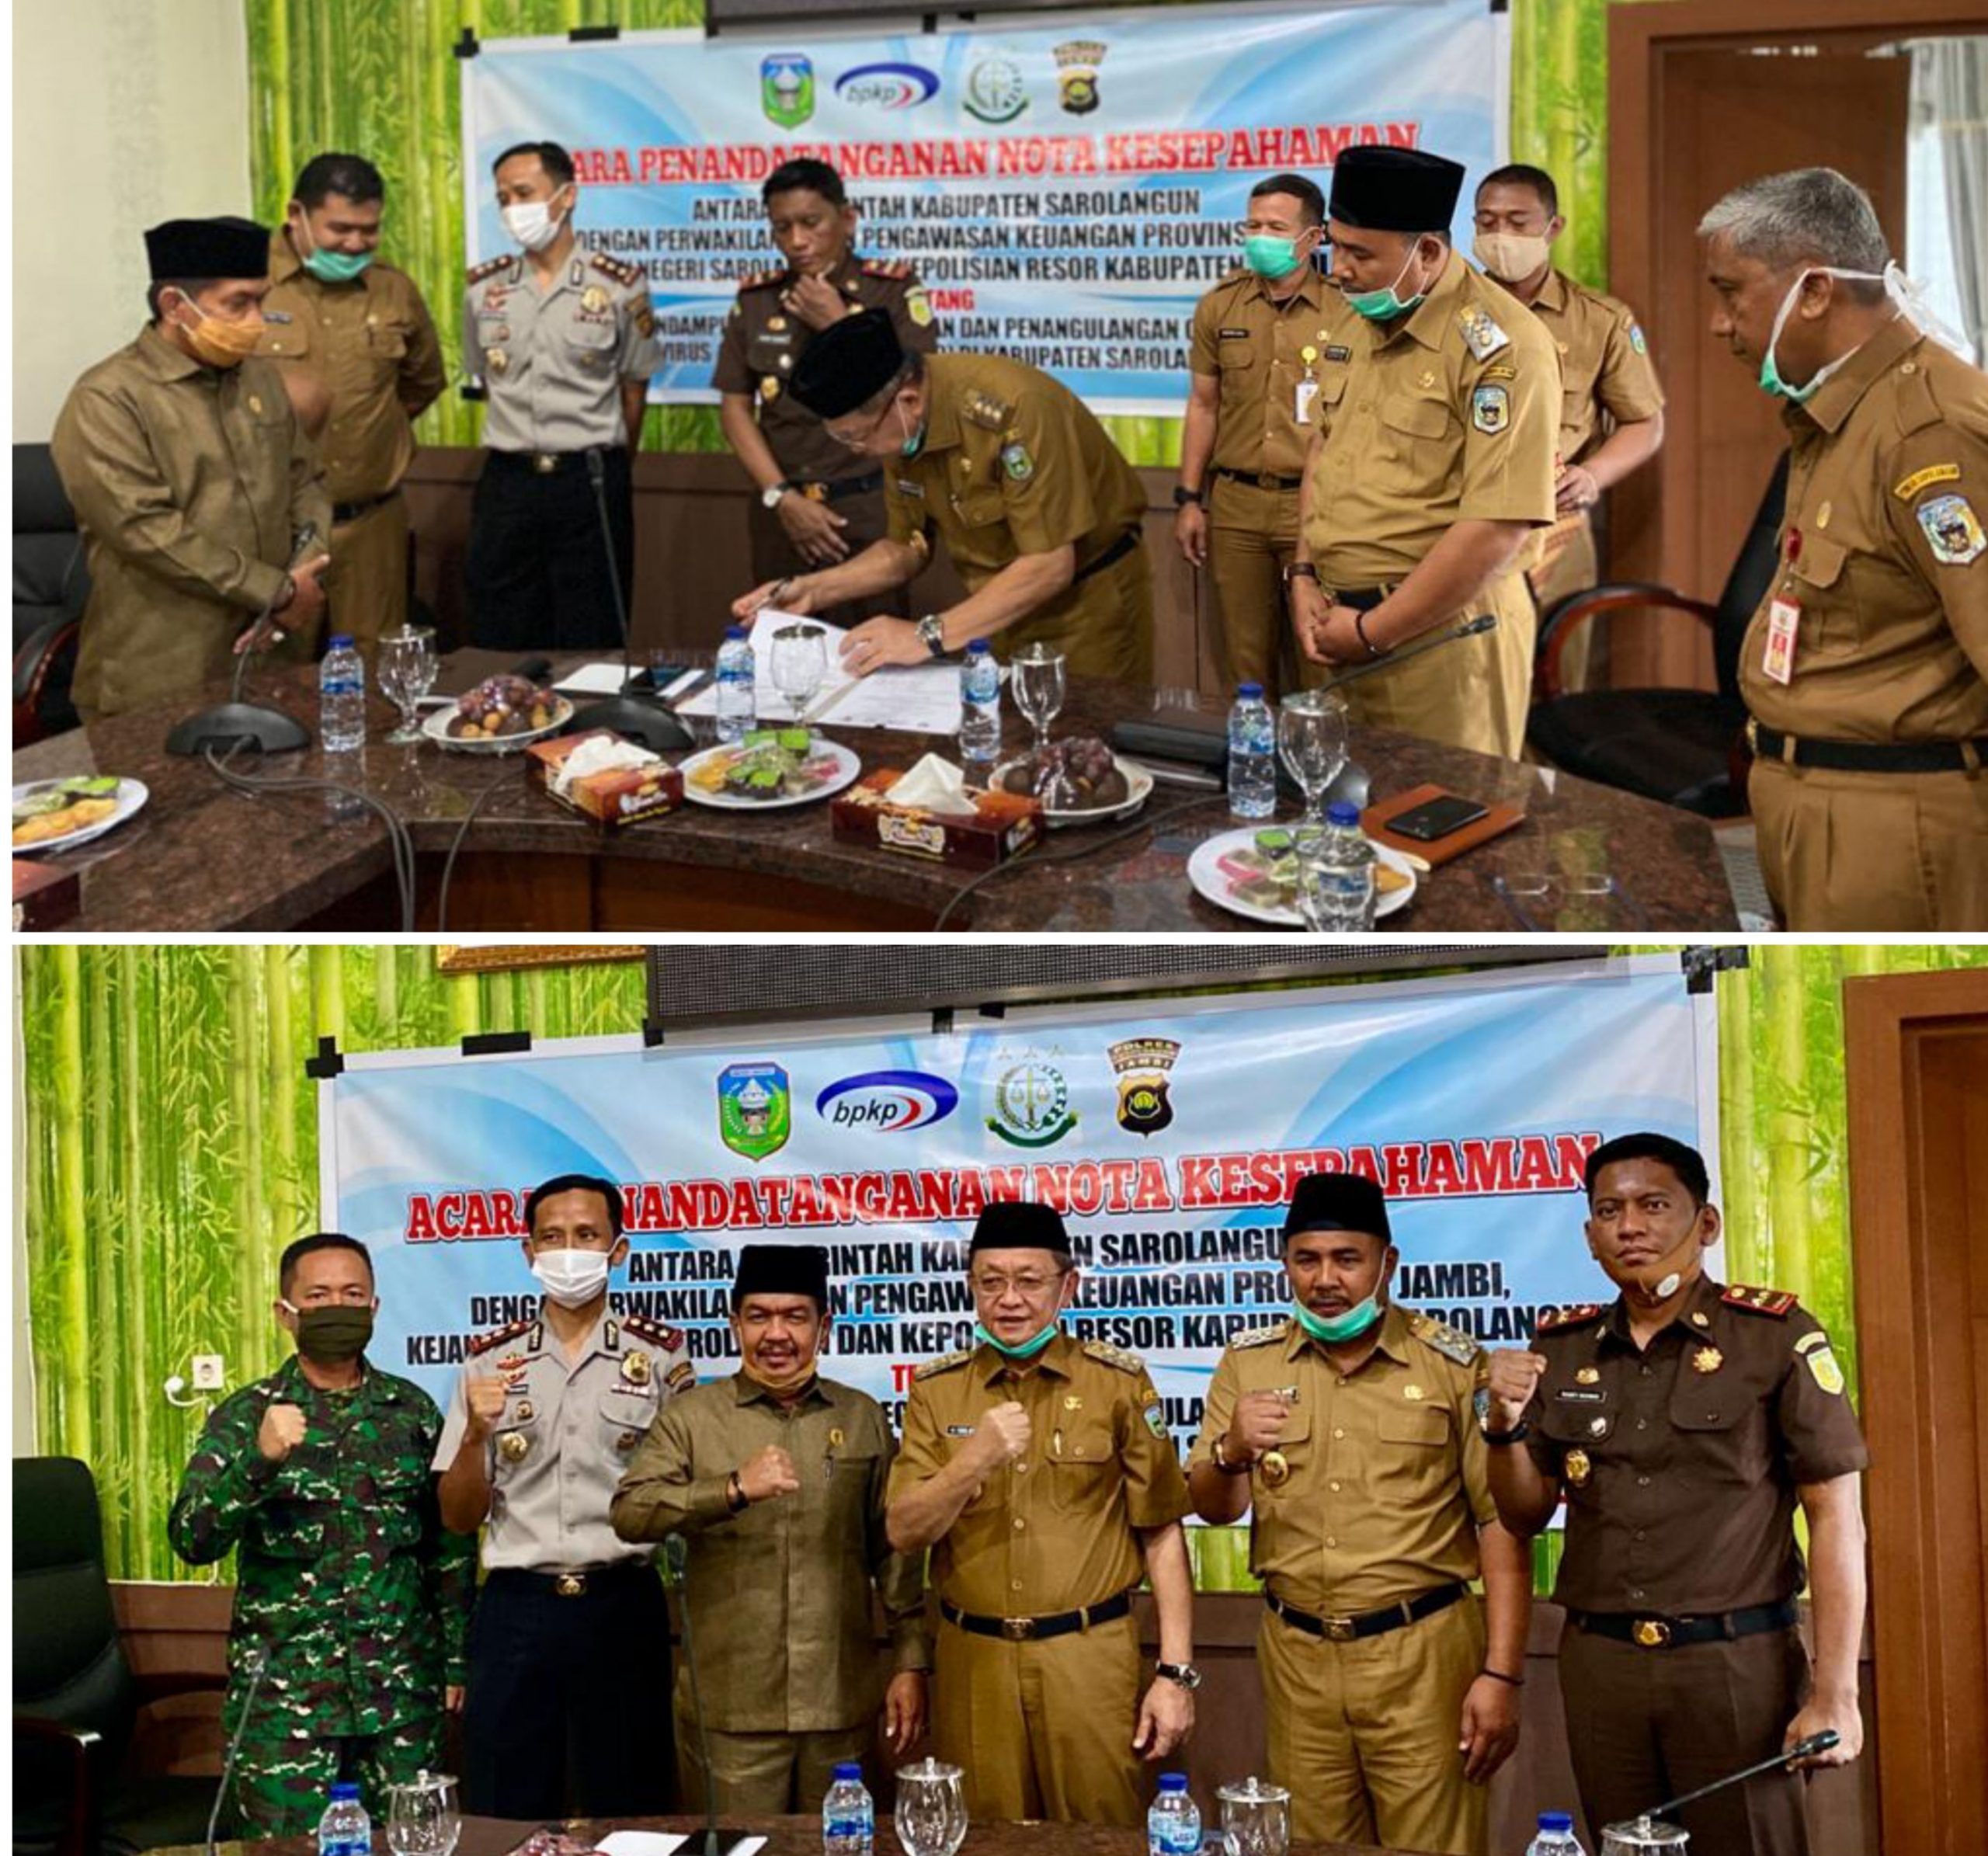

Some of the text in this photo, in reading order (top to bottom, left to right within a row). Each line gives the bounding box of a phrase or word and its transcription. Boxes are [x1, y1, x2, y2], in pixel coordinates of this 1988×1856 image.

[572, 149, 632, 182] ARA
[639, 141, 988, 182] PENANDNGANAN
[997, 136, 1097, 176] NOTA
[912, 194, 1039, 219] KABUPATEN
[1045, 189, 1200, 217] SAROLANGUN
[863, 226, 1009, 249] PENGAWASAN
[1016, 224, 1135, 249] KEUANGAN
[1143, 221, 1244, 248] PROVINS
[1027, 256, 1098, 280] RESOR
[926, 289, 975, 311] TANG
[961, 318, 999, 339] DAN
[1006, 317, 1179, 340] PENANGULANGAN
[1106, 346, 1189, 370] SAROLA
[832, 1097, 898, 1128] bpkp
[621, 1170, 1024, 1232] NANDATANGANAN
[1034, 1157, 1173, 1215] NOTA
[628, 1249, 735, 1283] ANTARA
[1100, 1227, 1285, 1267] SAROLANGU
[471, 1295, 546, 1326] DENG
[610, 1288, 732, 1320] RWAKILA
[855, 1281, 974, 1316] PENGAW
[1397, 1261, 1510, 1302] JAMBI,
[837, 1322, 895, 1356] DAN
